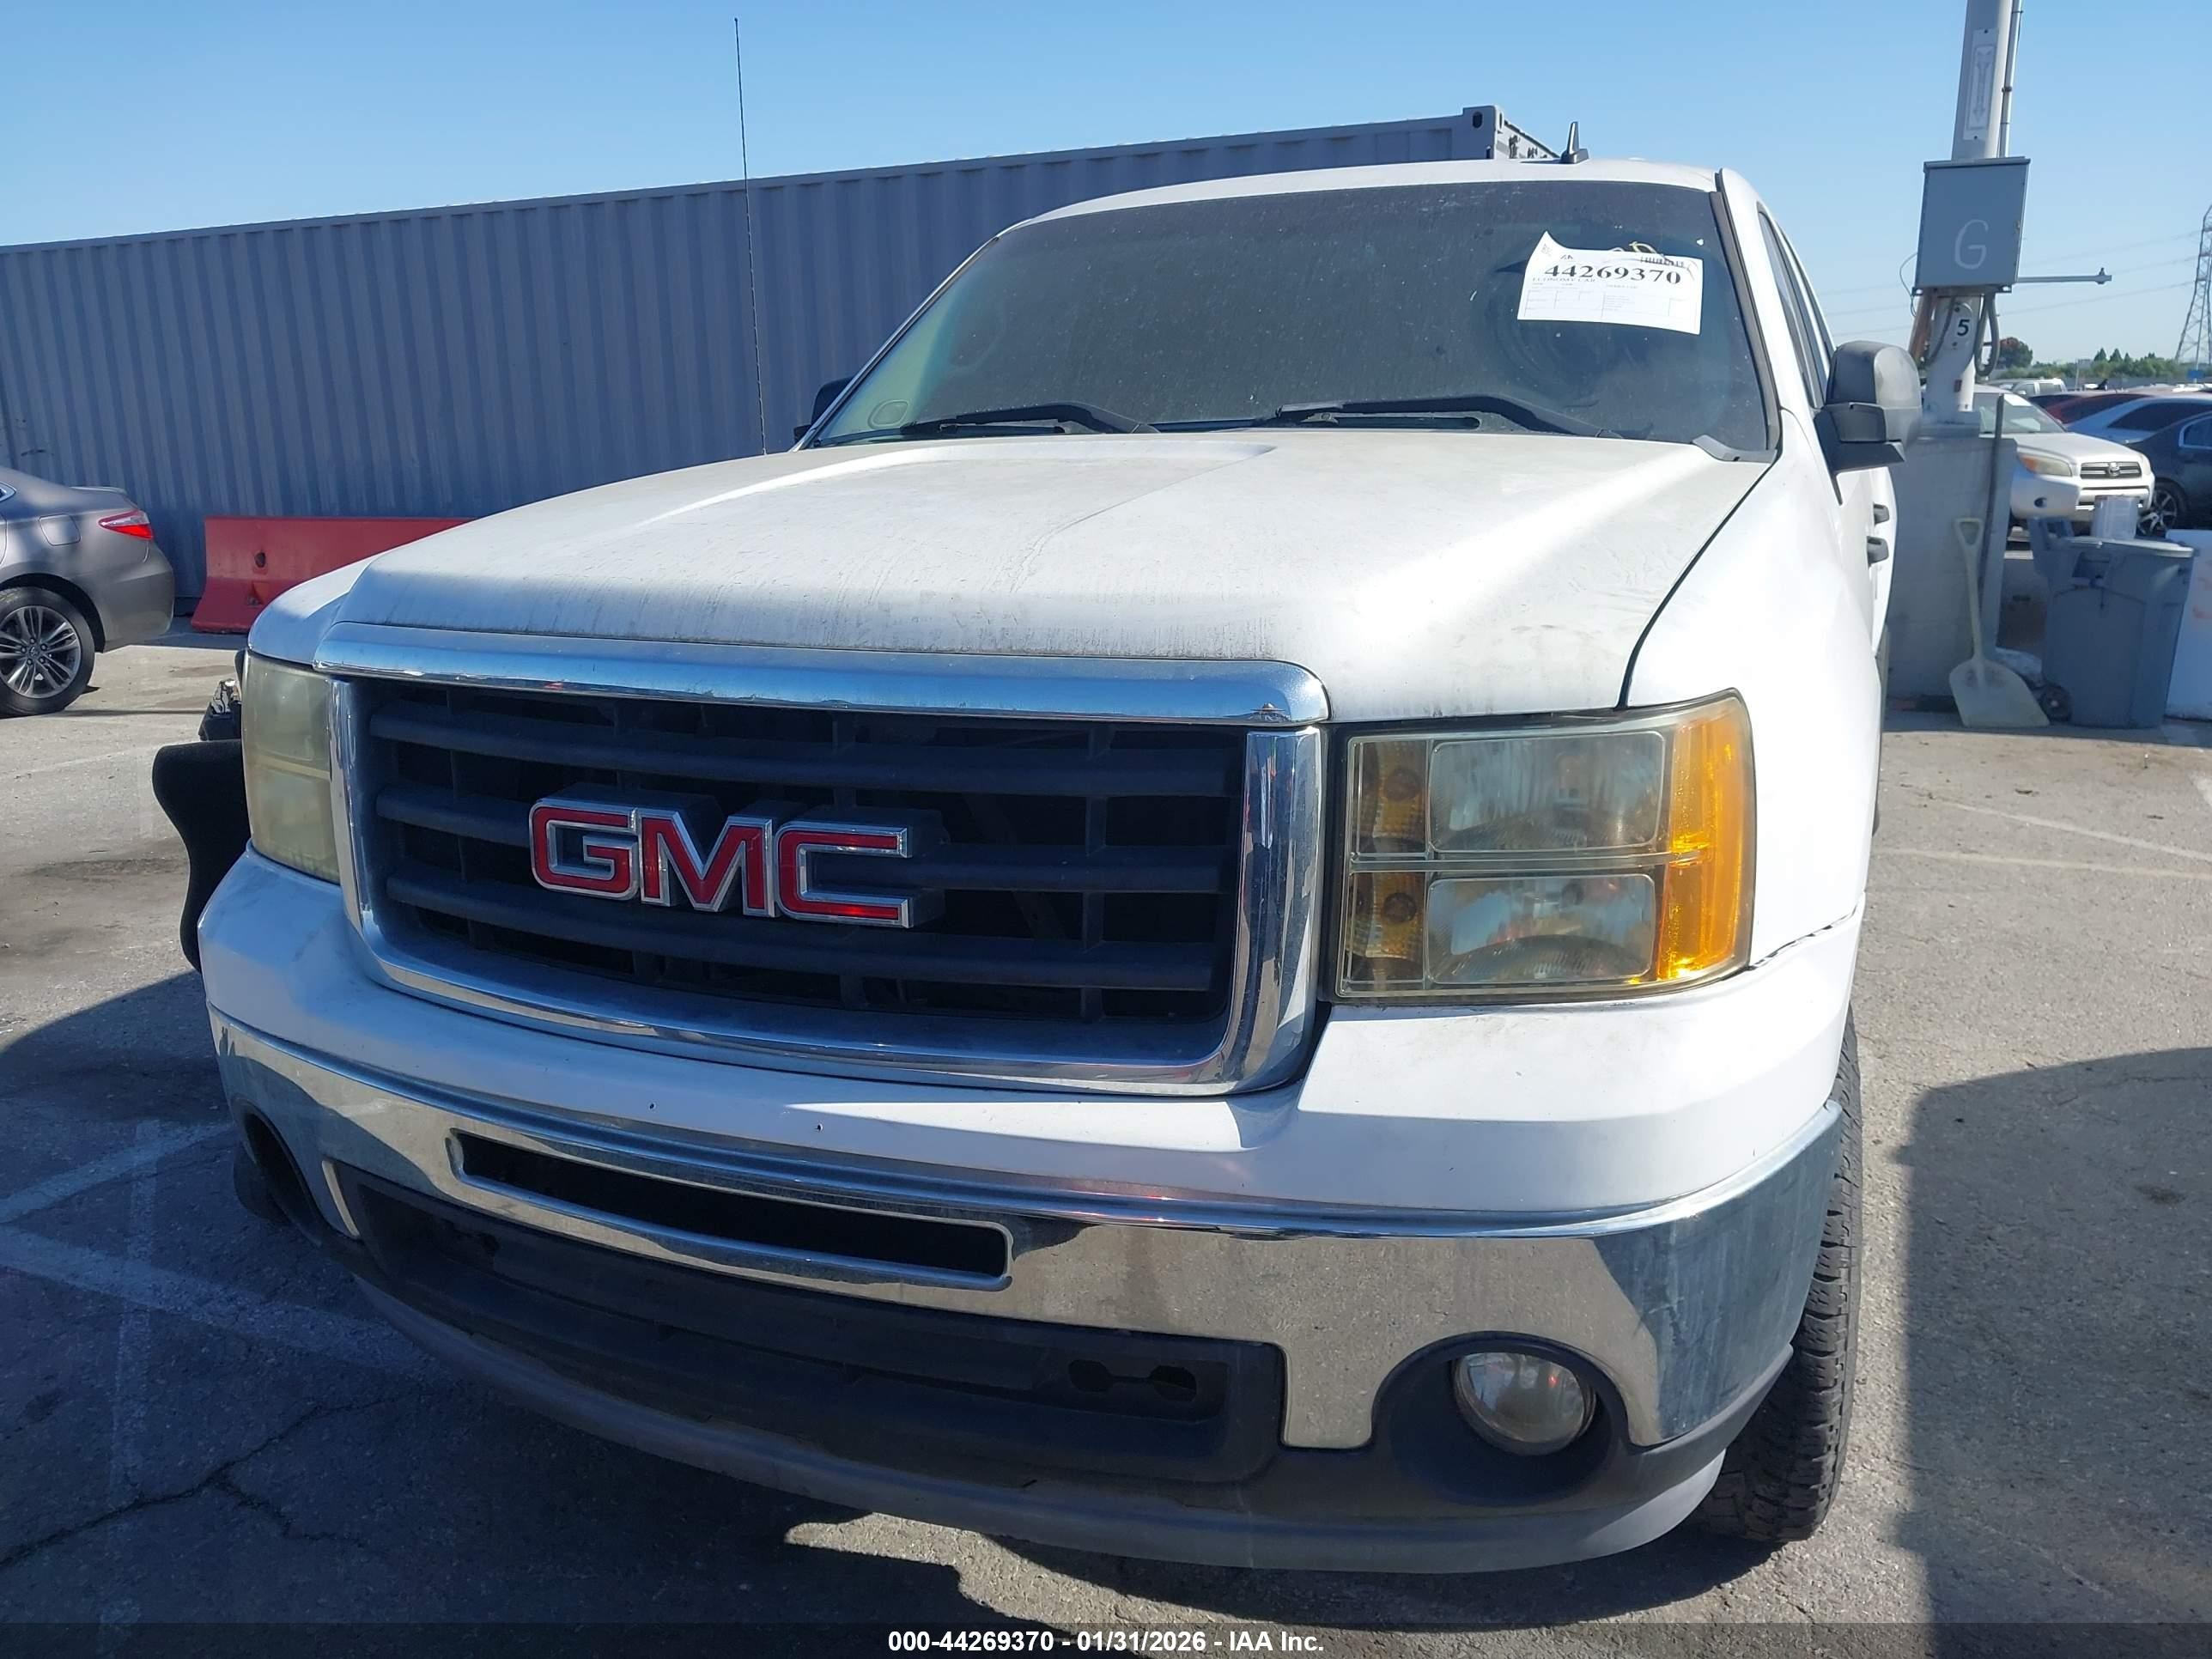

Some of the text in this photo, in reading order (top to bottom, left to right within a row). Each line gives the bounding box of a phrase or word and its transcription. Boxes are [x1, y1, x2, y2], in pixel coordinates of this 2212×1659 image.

[1954, 219, 1989, 270] G
[1544, 264, 1681, 285] 44269370
[1956, 319, 1970, 337] 5
[529, 798, 913, 928] GMC
